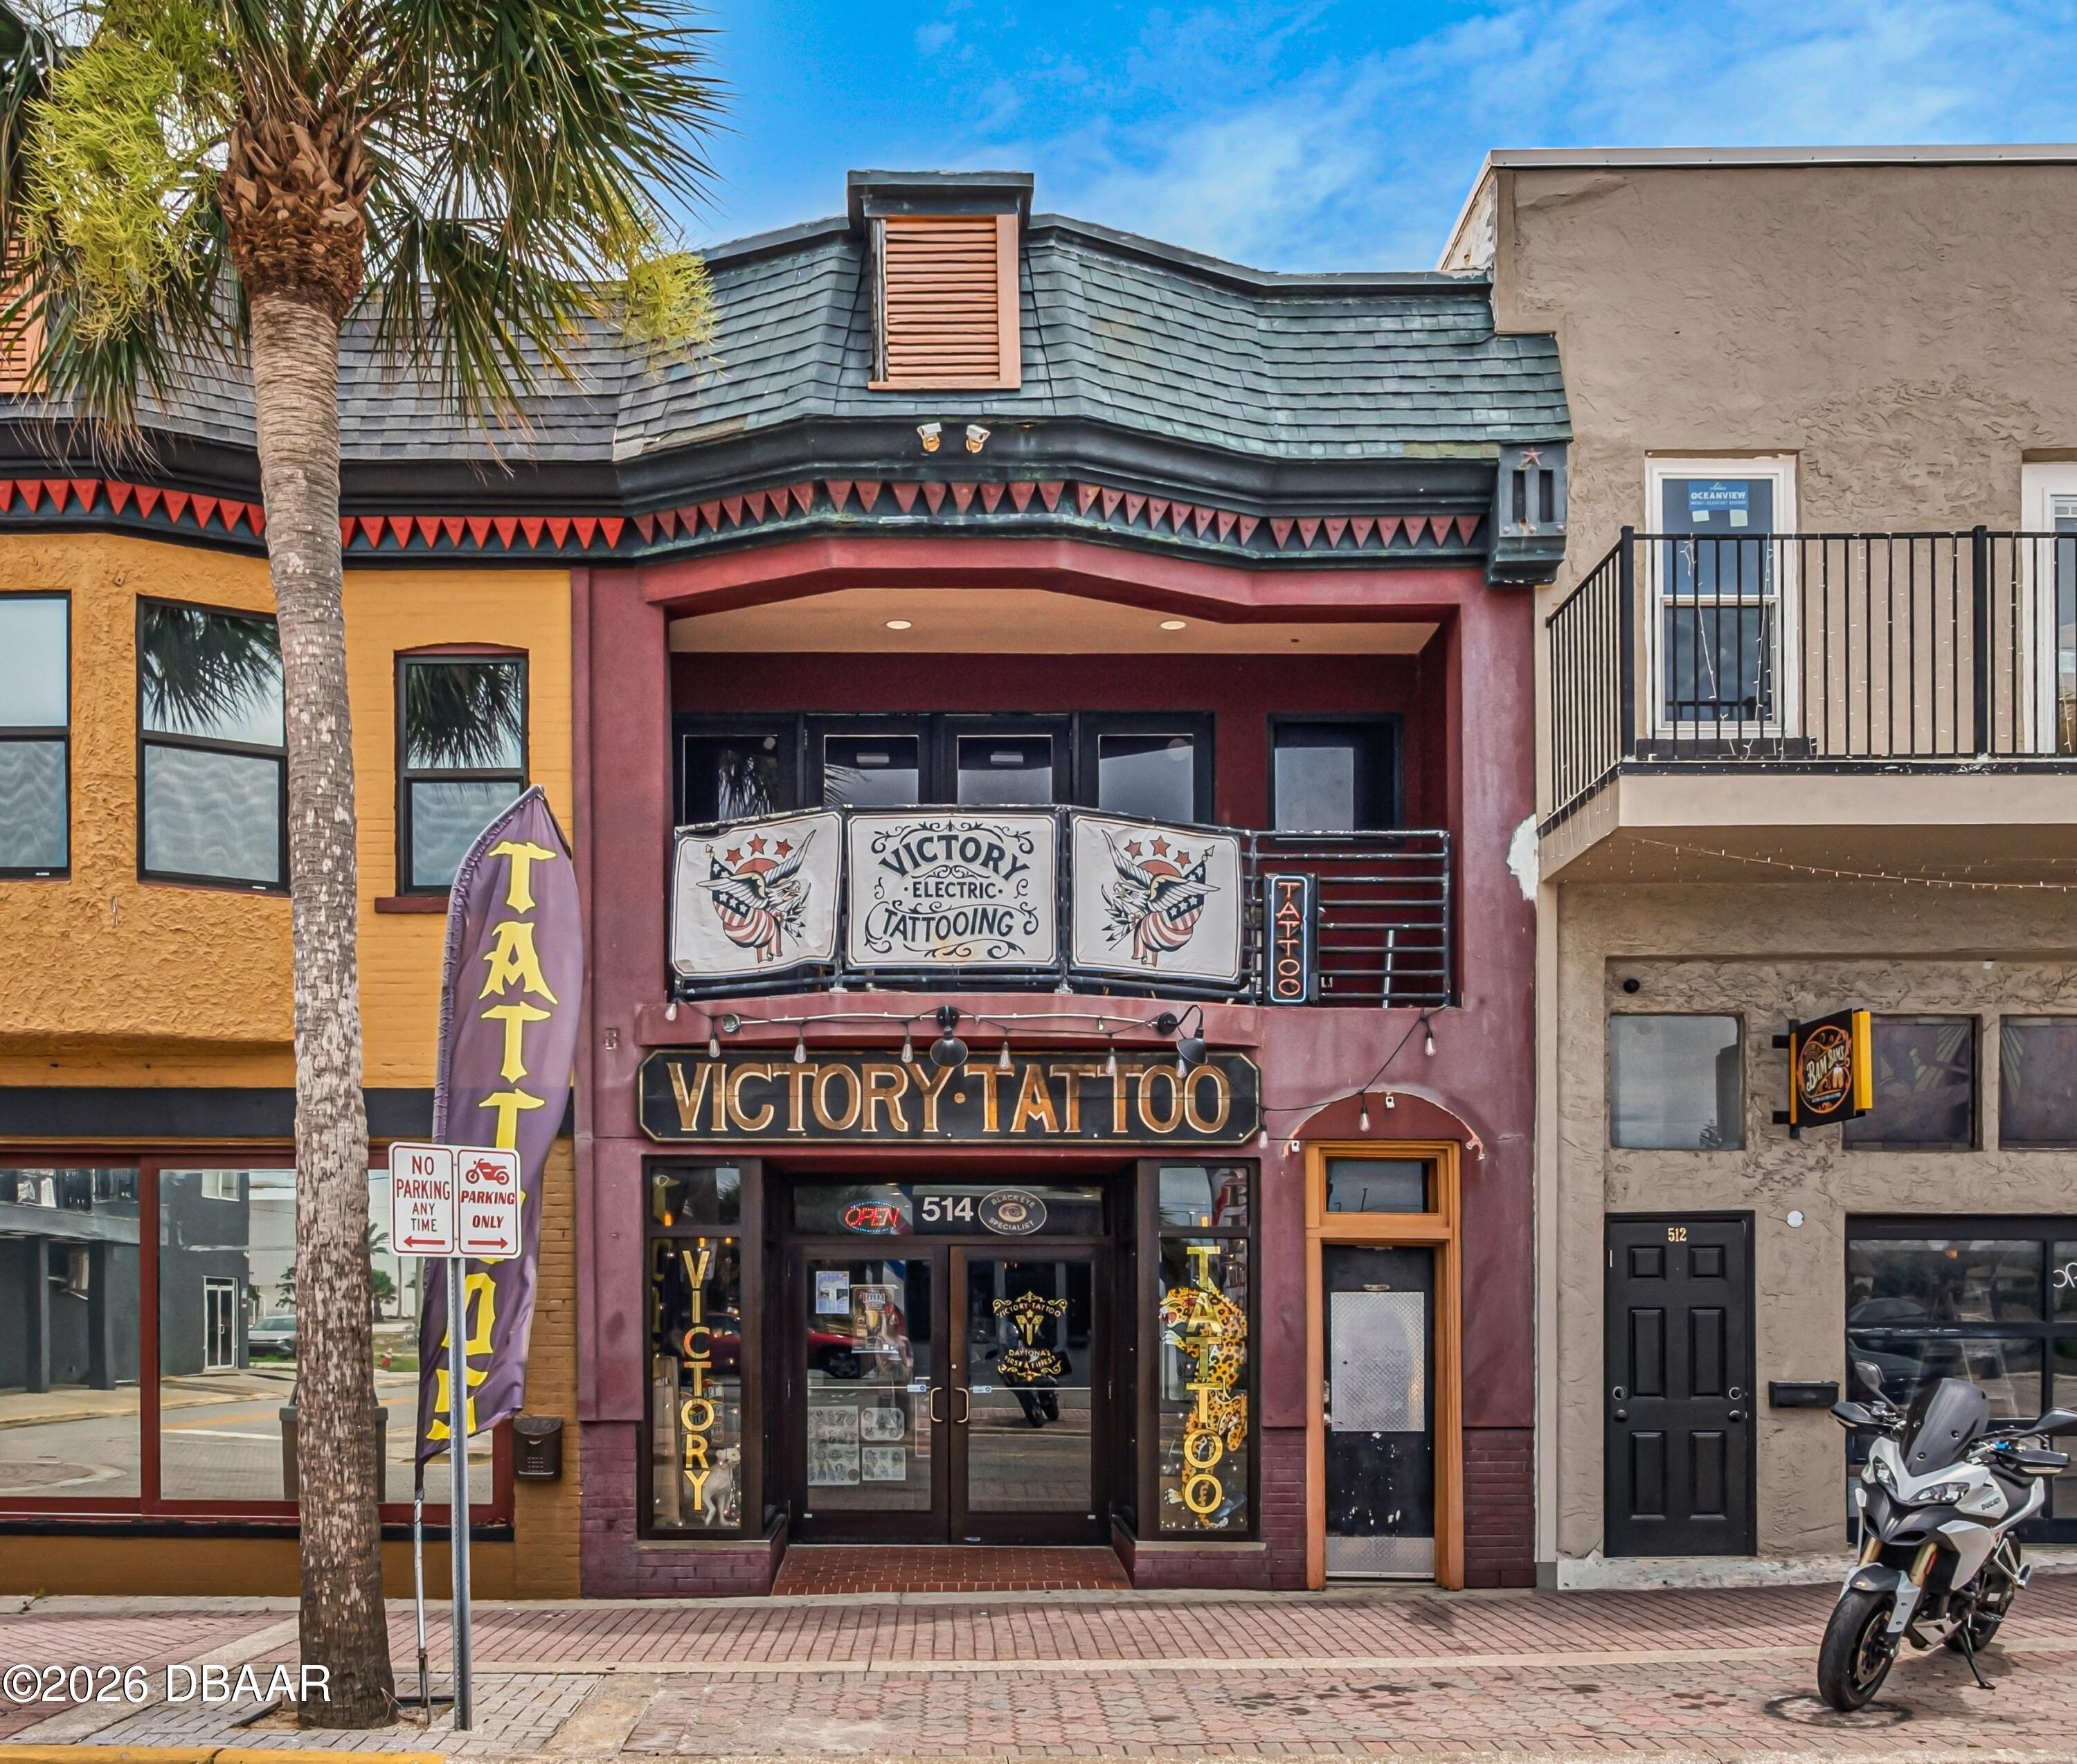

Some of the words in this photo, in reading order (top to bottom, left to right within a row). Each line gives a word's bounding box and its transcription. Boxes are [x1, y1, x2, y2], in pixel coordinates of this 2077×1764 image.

[878, 834, 1031, 881] VICTORY
[912, 881, 997, 899] ELECTRIC
[882, 907, 1015, 943] TATTOOING
[1276, 881, 1302, 996] TATTOO
[1806, 1054, 1828, 1092] BAM
[667, 1062, 955, 1133] VICTORY
[964, 1063, 1232, 1134] TATTOO
[411, 1155, 435, 1176] NO
[396, 1178, 451, 1200] PARKING
[460, 1190, 516, 1205] PARKING
[412, 1202, 435, 1216] ANY
[921, 1196, 974, 1222] 514
[991, 1194, 1019, 1205] BLACK
[1020, 1196, 1036, 1208] EYE
[411, 1218, 438, 1232] TIME
[472, 1214, 505, 1229] ONLY
[845, 1207, 900, 1227] OPEN
[988, 1217, 1034, 1230] SPECIALIST
[1668, 1227, 1687, 1242] 512
[680, 1250, 714, 1511] VICTORY
[1183, 1245, 1223, 1514] TATTOO
